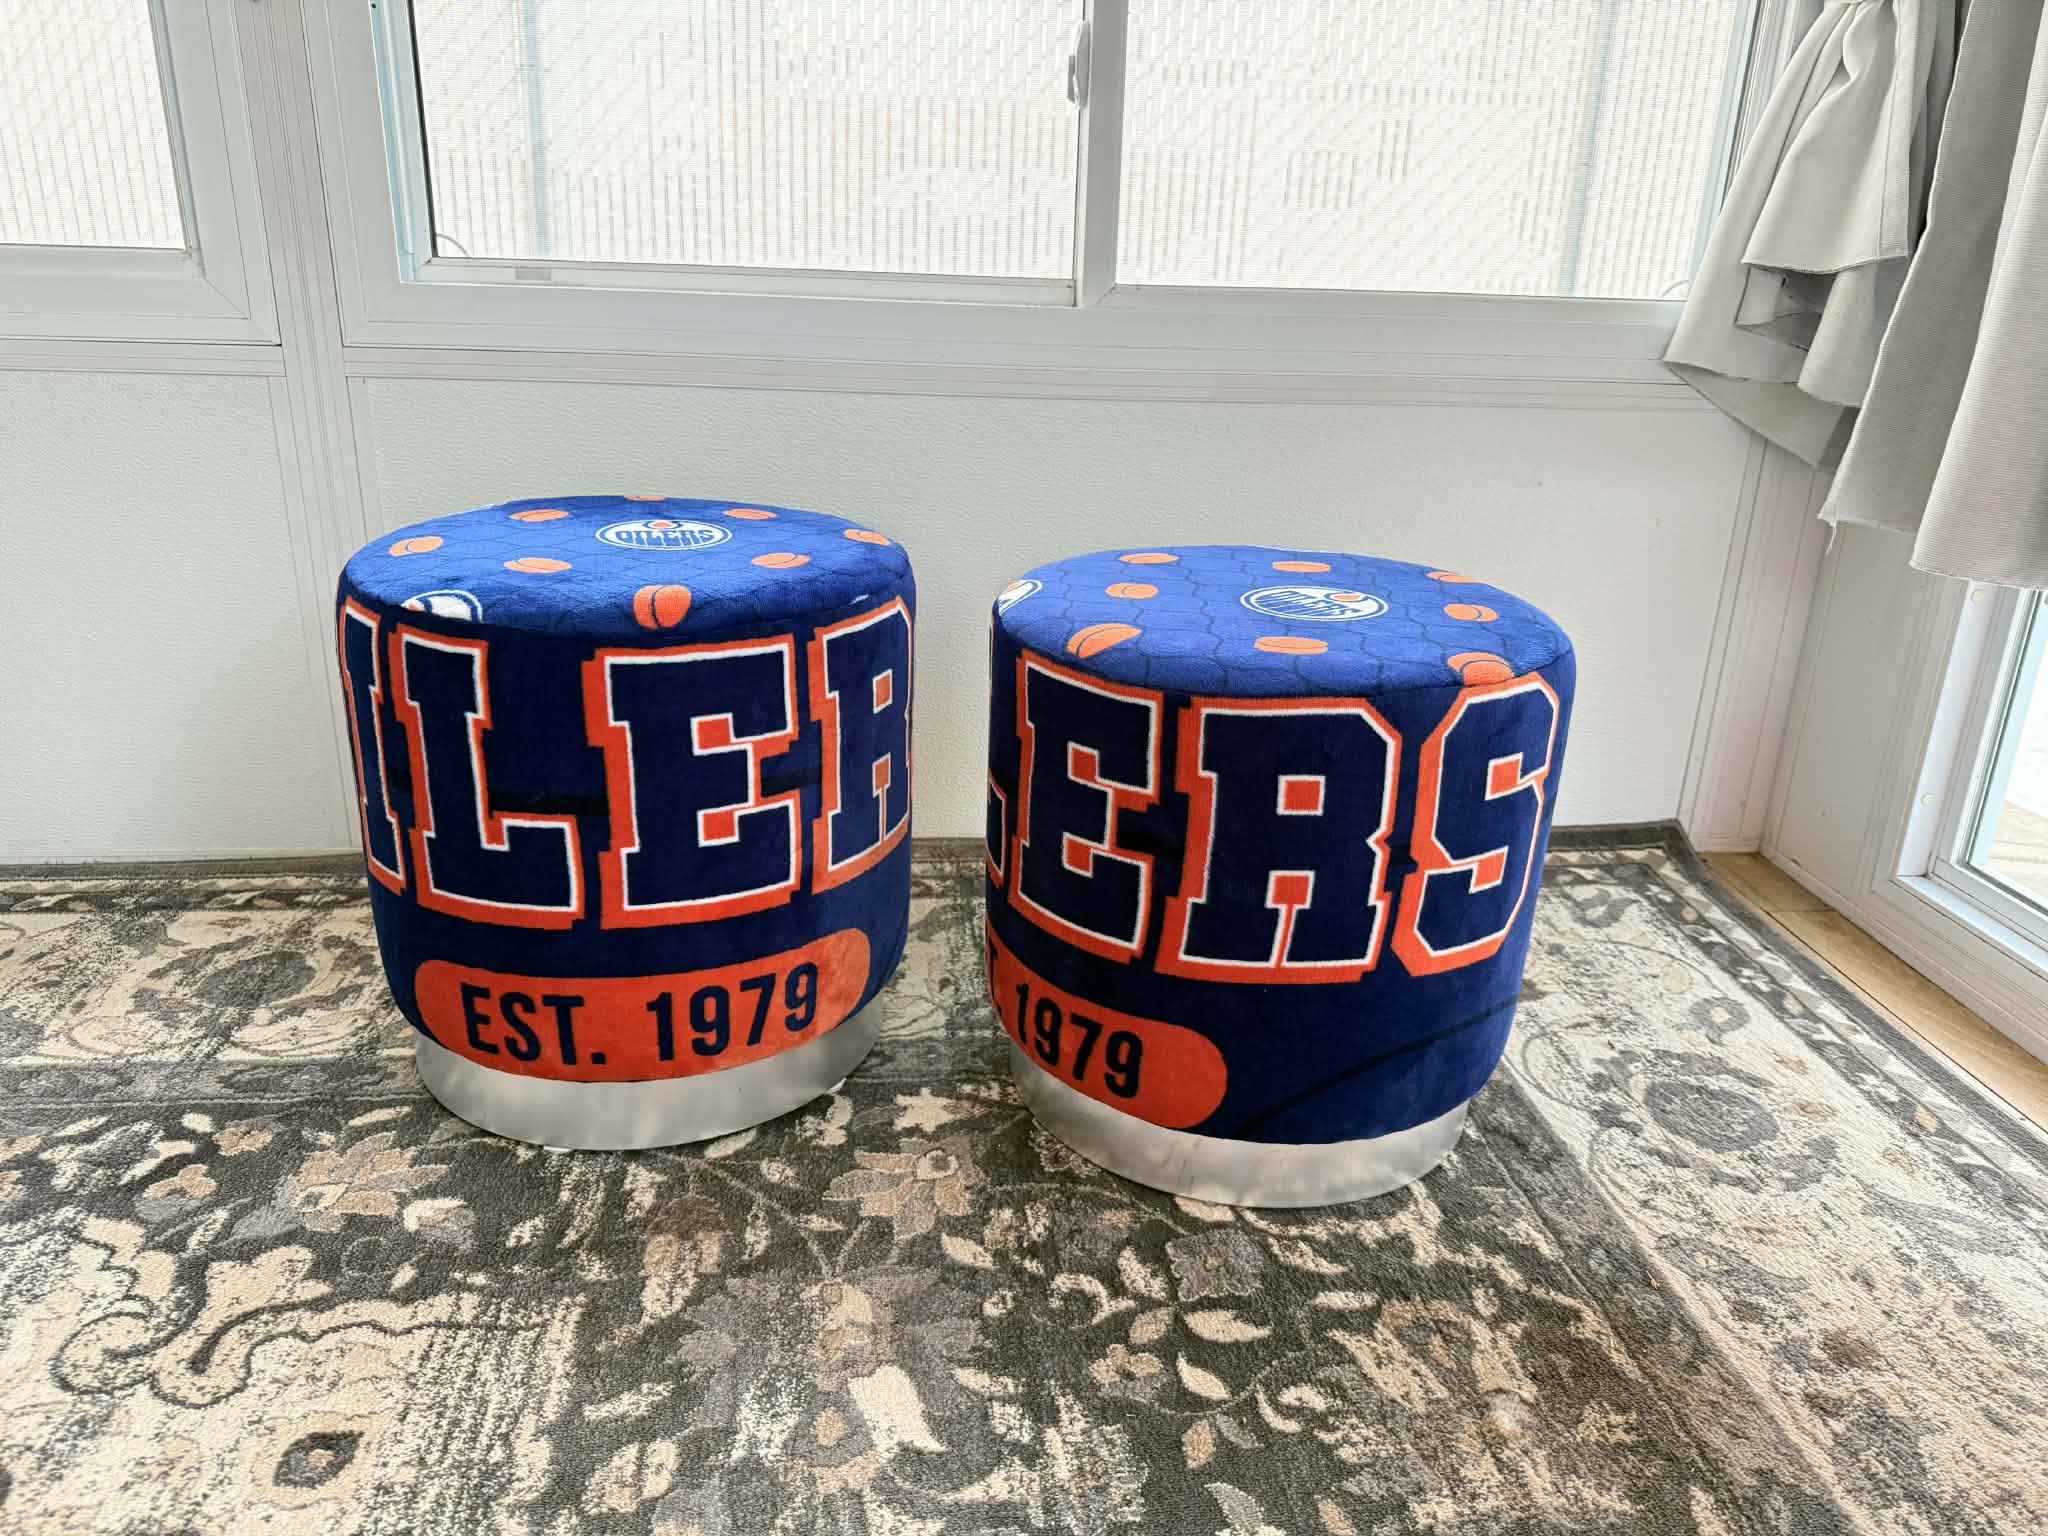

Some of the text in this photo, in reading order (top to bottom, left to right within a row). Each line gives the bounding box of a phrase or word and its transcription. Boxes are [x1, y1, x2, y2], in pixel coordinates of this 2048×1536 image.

[615, 529, 715, 547] OILERS
[985, 649, 1561, 985] ERS
[460, 961, 819, 1066] EST. 1979
[1016, 982, 1144, 1099] 1979
